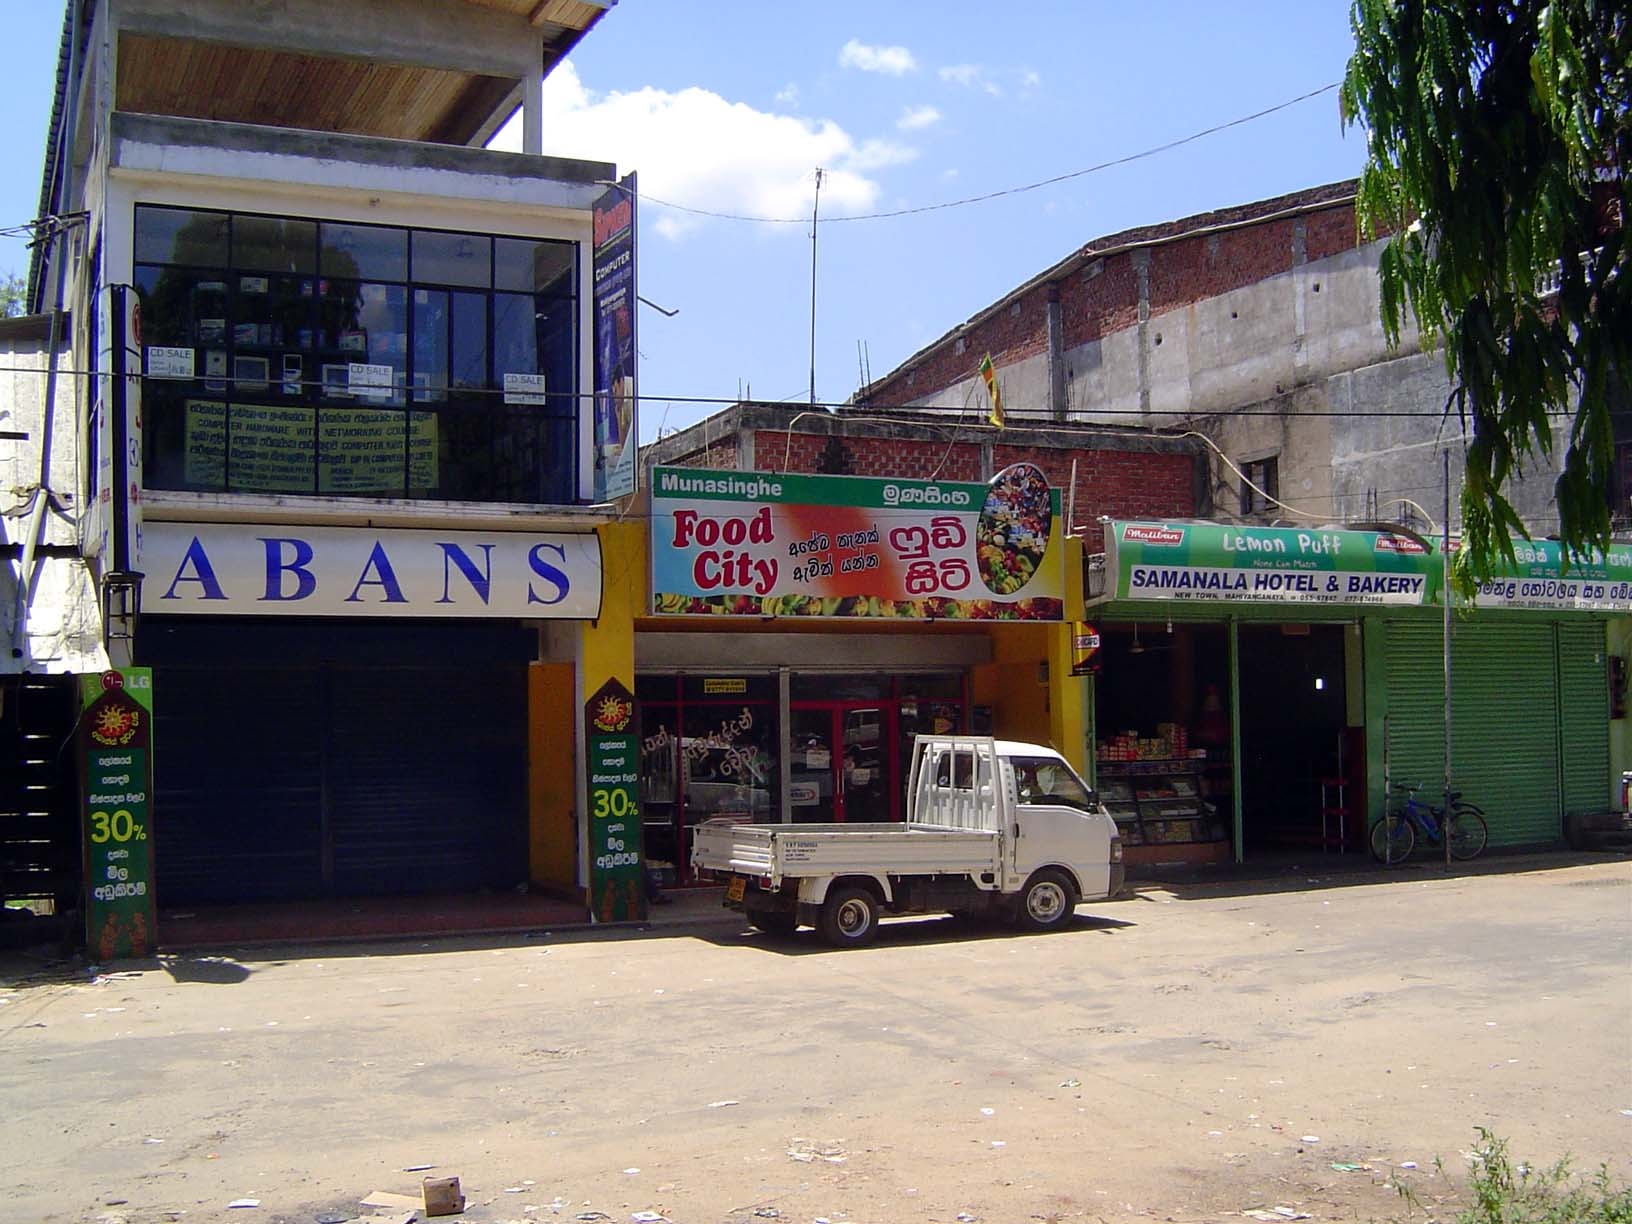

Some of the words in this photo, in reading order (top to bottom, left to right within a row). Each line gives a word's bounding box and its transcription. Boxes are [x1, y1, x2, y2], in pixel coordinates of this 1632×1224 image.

[595, 250, 631, 282] COMPUTER
[150, 348, 165, 357] CD
[167, 349, 192, 359] SALE
[351, 364, 364, 373] CD
[367, 366, 390, 376] SALE
[505, 375, 518, 383] CD
[520, 376, 543, 385] SALE
[661, 473, 783, 499] Munasinghe
[673, 506, 775, 550] Food
[1127, 528, 1181, 541] Maliban
[1223, 533, 1286, 552] Lemon
[1298, 534, 1342, 555] Puff
[160, 536, 571, 605] ABANS
[693, 549, 779, 596] City
[1132, 569, 1248, 591] SAMANALA
[1254, 573, 1318, 592] HOTEL
[1326, 575, 1339, 592] &
[1348, 576, 1423, 594] BAKERY
[129, 676, 150, 689] LG
[593, 788, 639, 818] 30%
[91, 809, 146, 843] 30%
